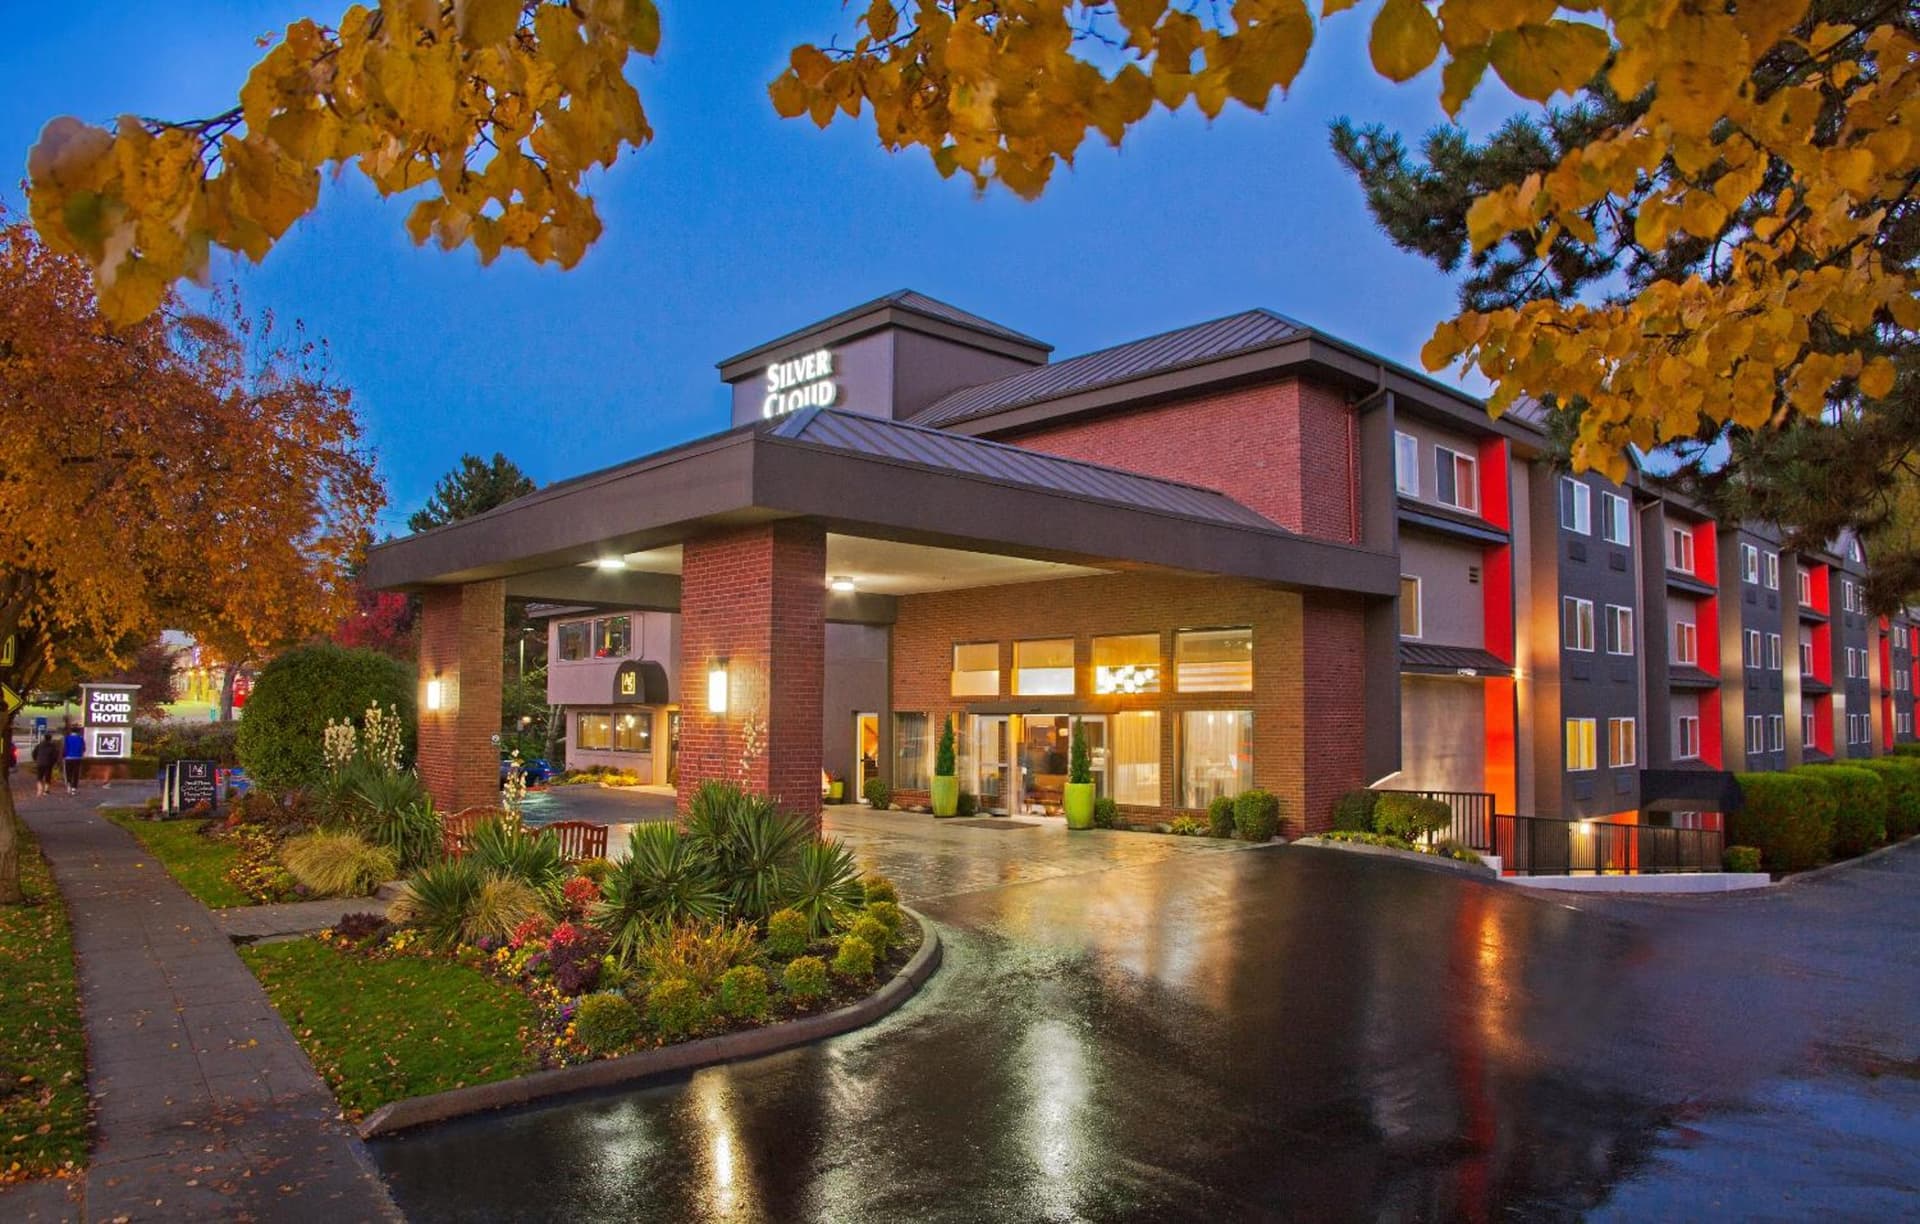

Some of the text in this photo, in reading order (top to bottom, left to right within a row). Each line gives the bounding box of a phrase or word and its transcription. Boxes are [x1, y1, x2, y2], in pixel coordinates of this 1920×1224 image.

[767, 349, 833, 393] SILVER
[763, 381, 837, 419] CLOUD
[92, 691, 130, 702] SILVER
[90, 702, 131, 712] CLOUD
[92, 712, 129, 723] HOTEL
